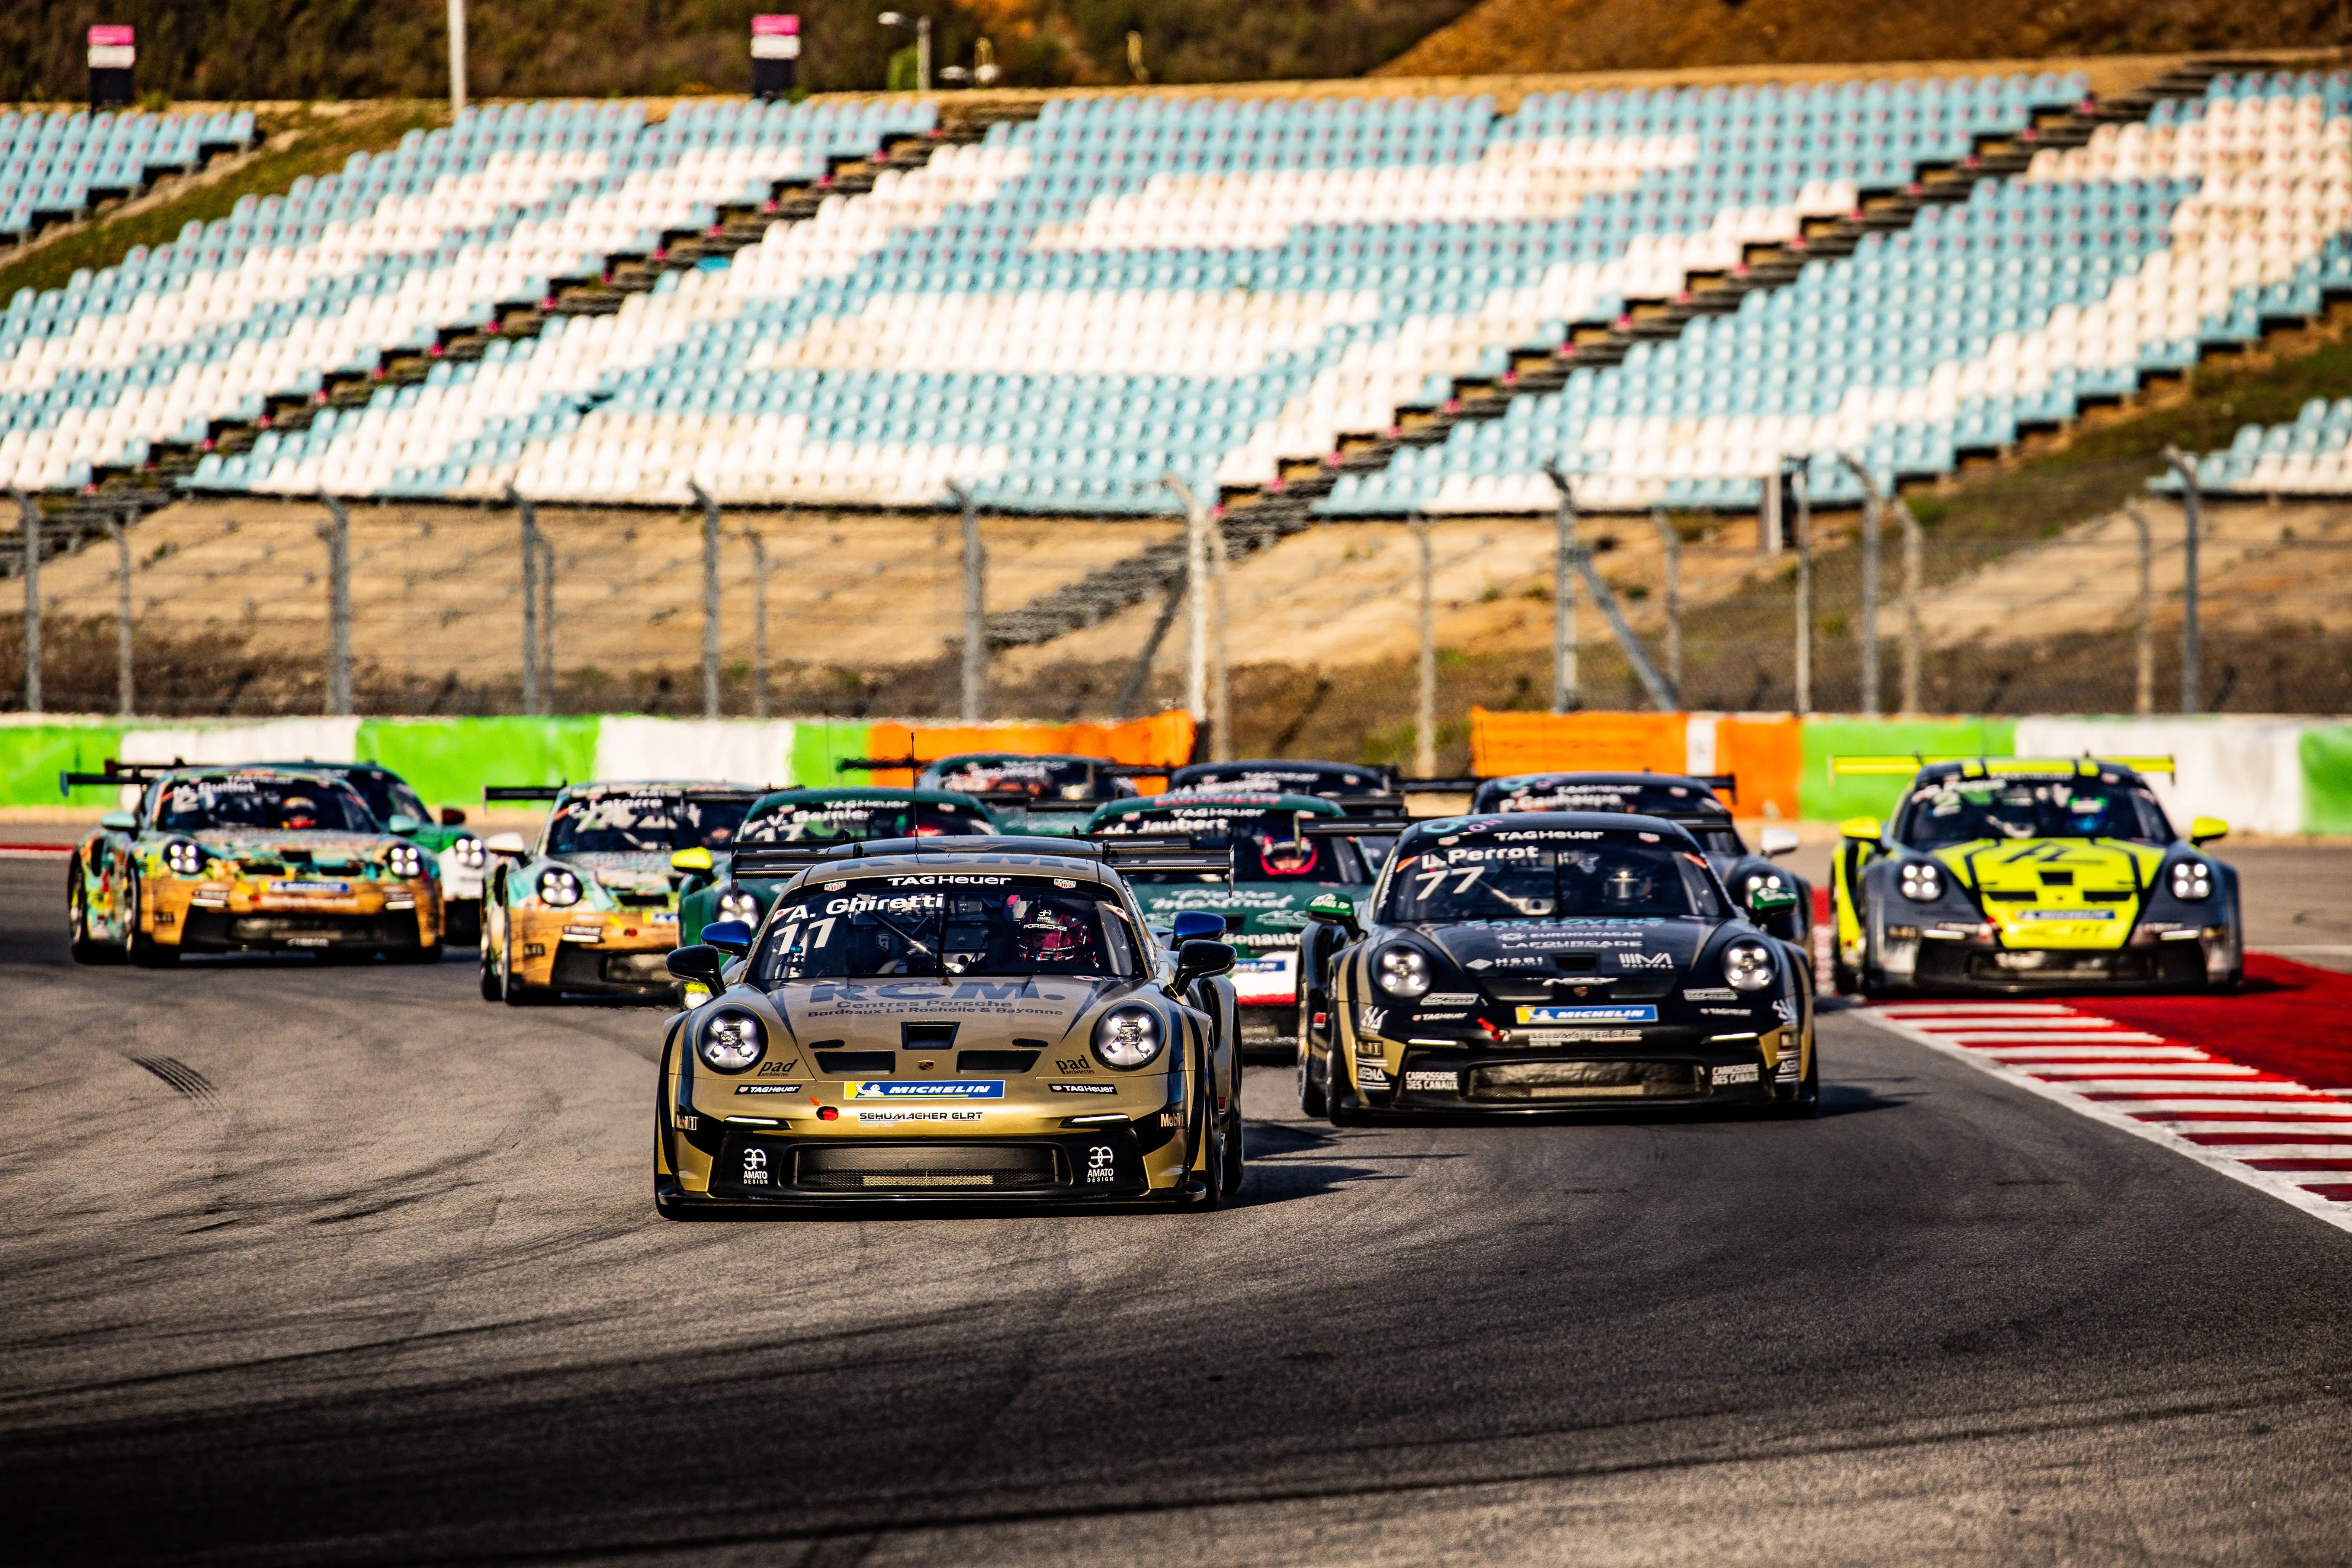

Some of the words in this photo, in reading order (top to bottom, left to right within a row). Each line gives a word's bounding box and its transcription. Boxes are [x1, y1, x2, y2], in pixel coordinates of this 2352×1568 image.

[1170, 808, 1266, 818] TAGHeuer
[1137, 818, 1229, 834] Jaubert
[1494, 830, 1604, 841] TAGHeuer
[887, 875, 1012, 886] TAGHeuer
[1415, 866, 1485, 901] 77
[786, 905, 816, 923] A.
[825, 893, 944, 915] Ghiretti
[773, 917, 837, 956] 11
[836, 1000, 919, 1008] Centres
[808, 1009, 881, 1017] Bordeaux
[1556, 1010, 1645, 1019] MICHELIN
[757, 1058, 799, 1077] pad
[1056, 1055, 1091, 1074] pad
[744, 1170, 768, 1179] AMATO
[1087, 1168, 1114, 1177] AMATO
